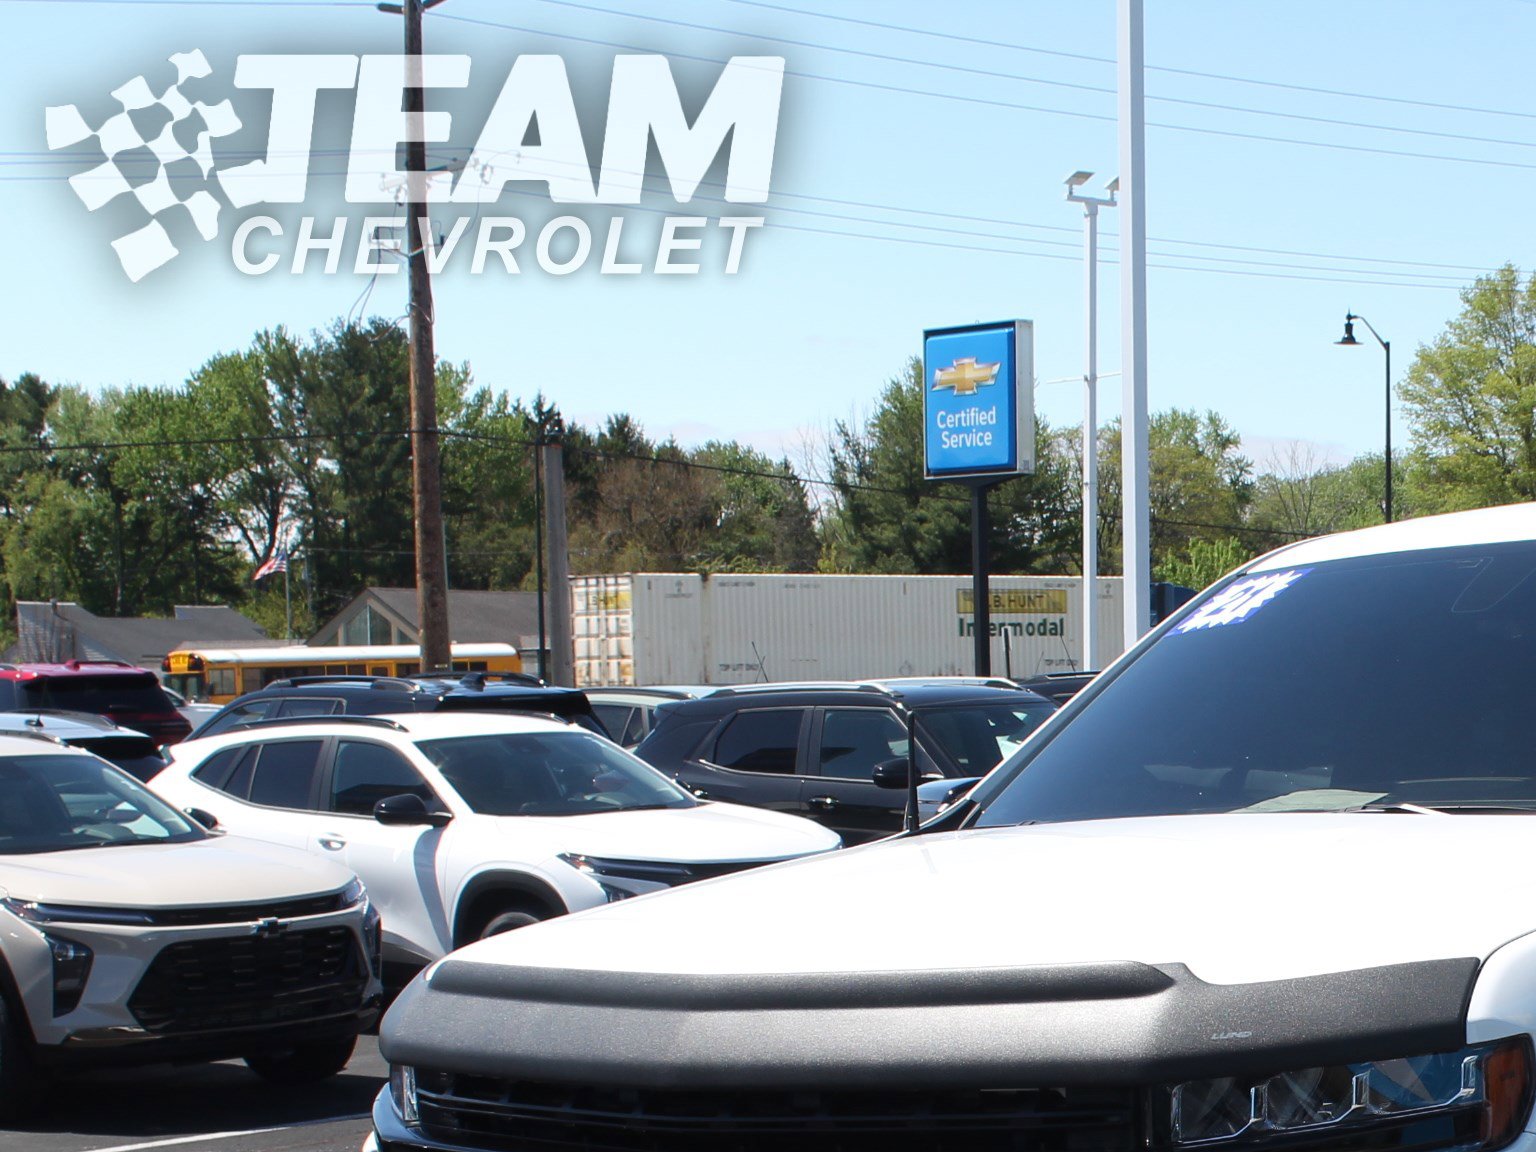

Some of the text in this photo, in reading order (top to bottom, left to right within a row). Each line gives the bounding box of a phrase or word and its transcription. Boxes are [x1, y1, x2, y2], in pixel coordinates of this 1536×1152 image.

[936, 405, 996, 429] Certified
[941, 429, 993, 449] Service
[1007, 594, 1045, 608] HUNT
